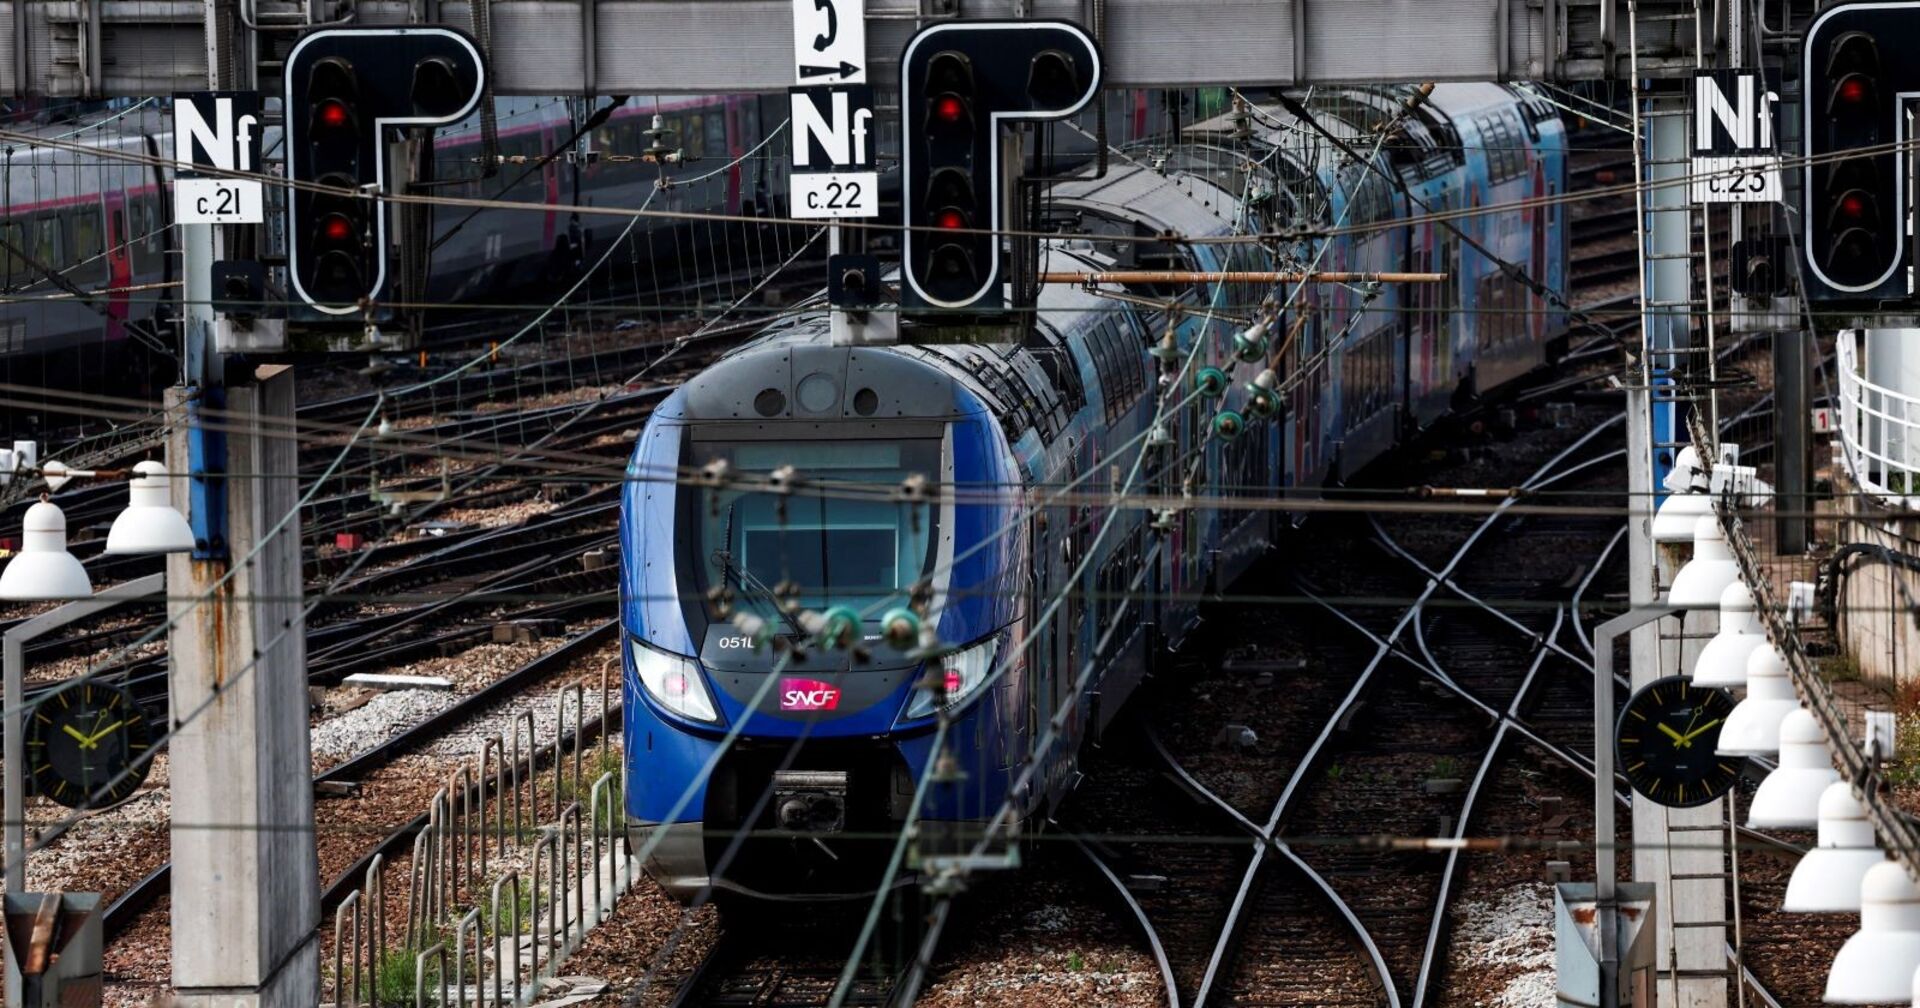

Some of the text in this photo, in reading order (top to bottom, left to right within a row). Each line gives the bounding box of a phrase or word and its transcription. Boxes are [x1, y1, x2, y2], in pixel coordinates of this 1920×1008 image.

[1696, 75, 1779, 150] Nf
[174, 98, 257, 171] Nf
[791, 92, 873, 166] Nf
[1709, 166, 1765, 193] c.23
[197, 188, 240, 214] c.21
[807, 182, 862, 209] c.22
[783, 690, 836, 706] SNCF
